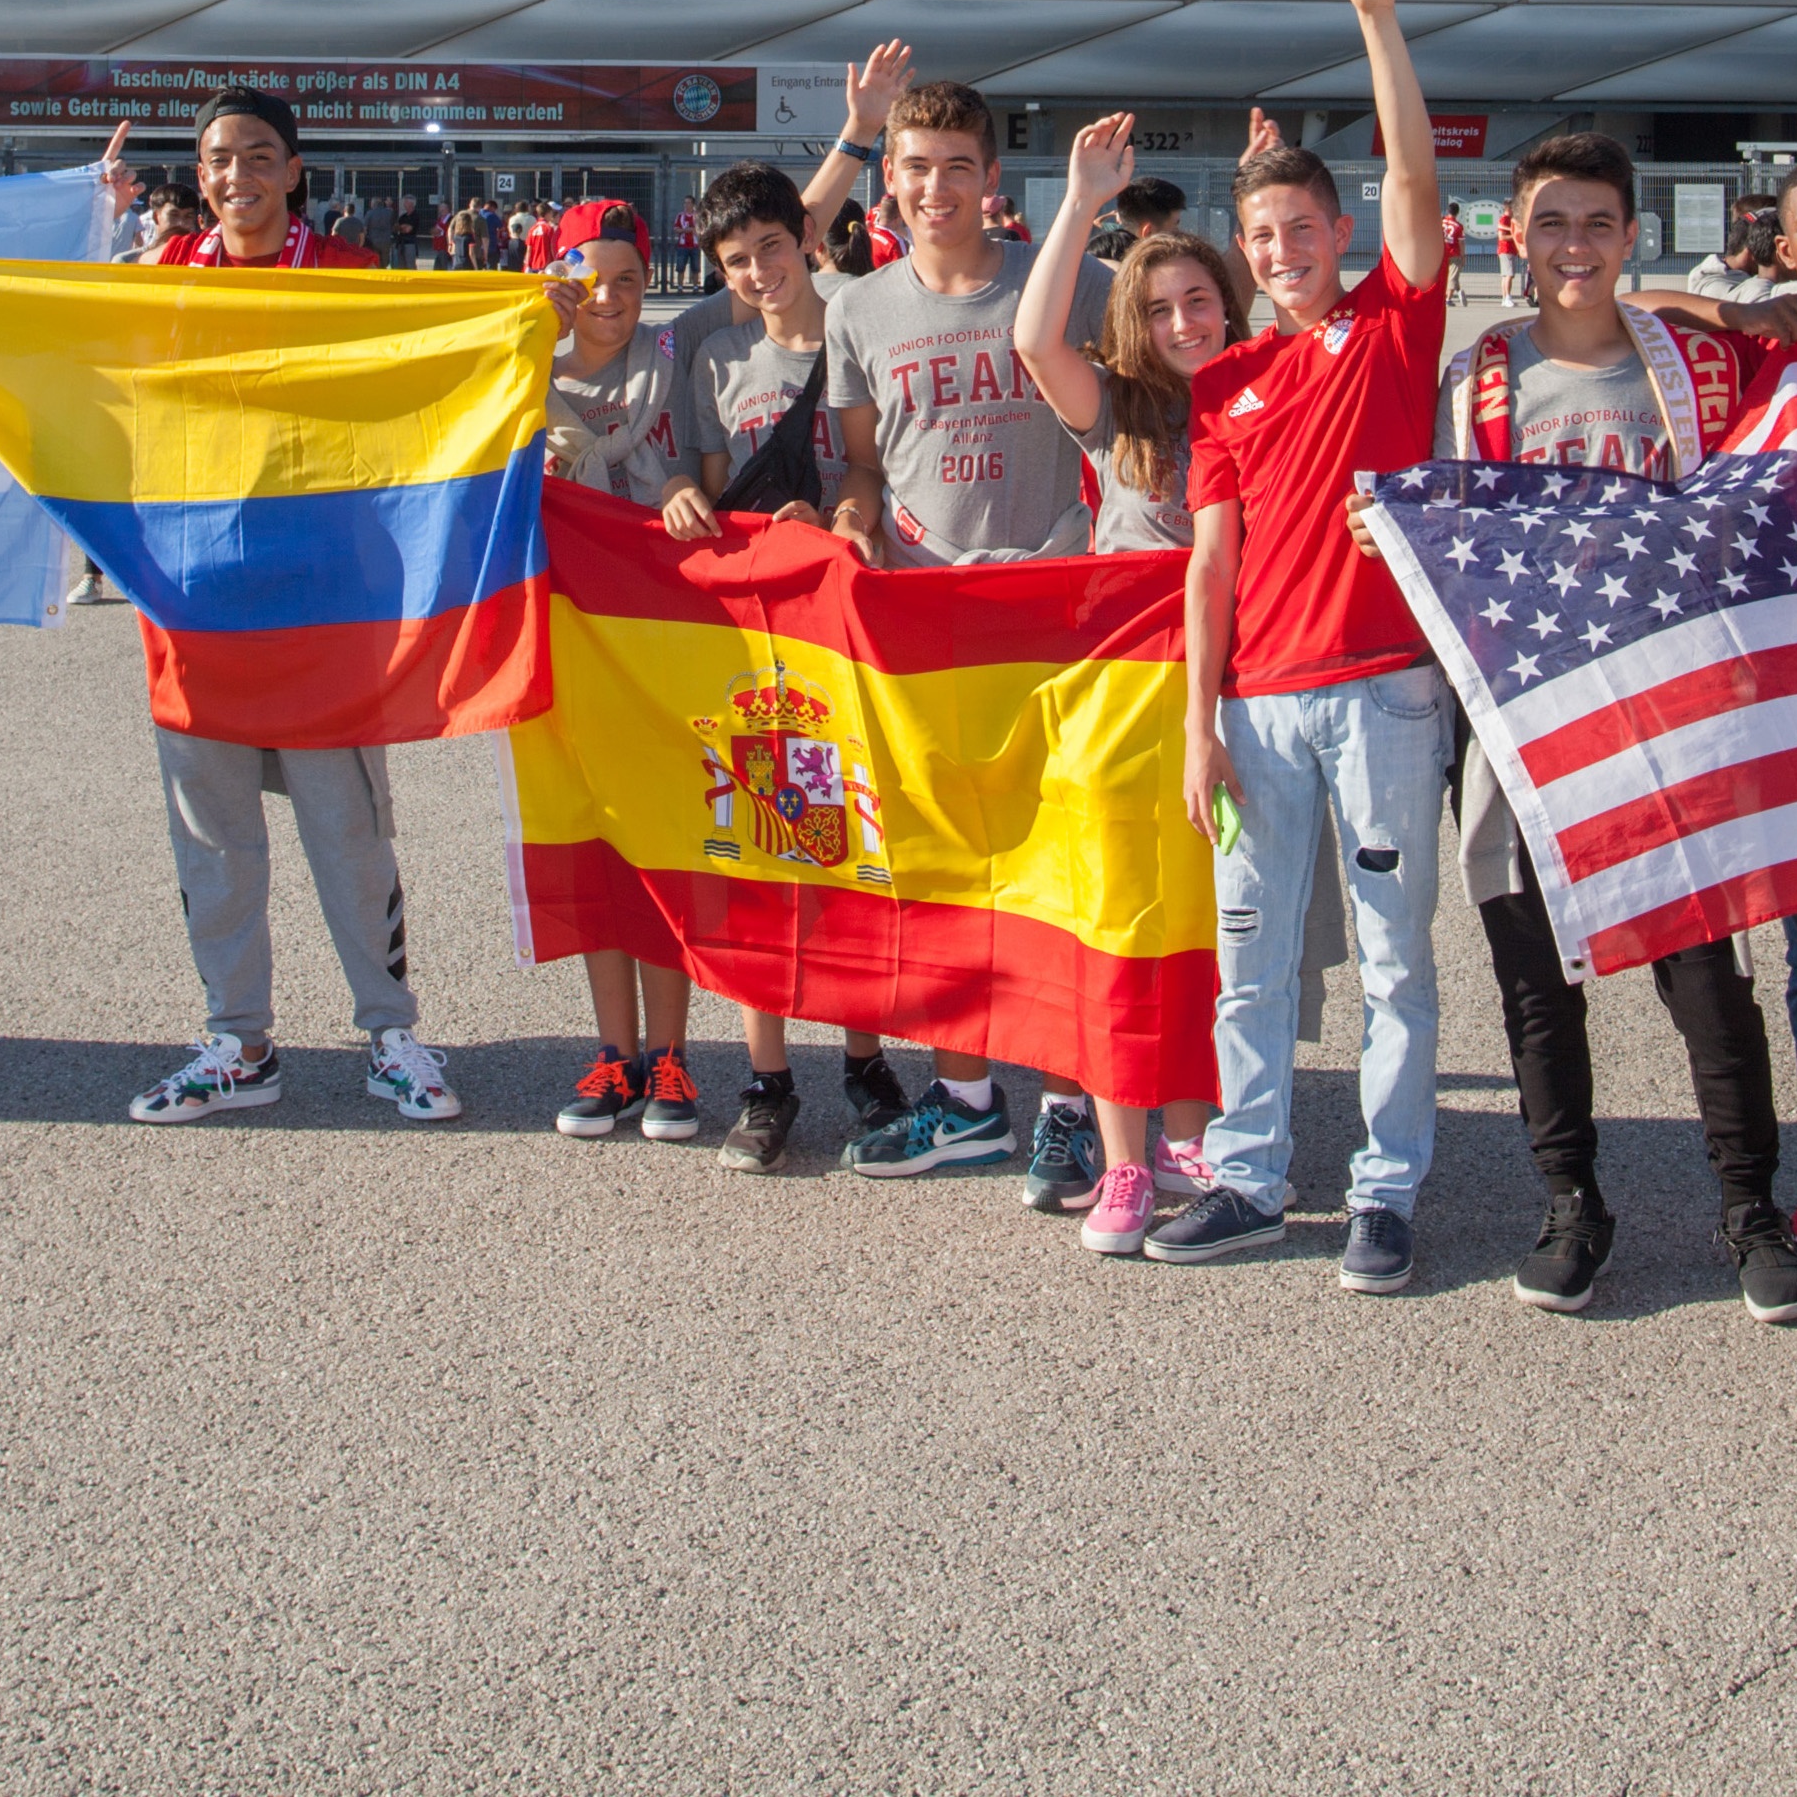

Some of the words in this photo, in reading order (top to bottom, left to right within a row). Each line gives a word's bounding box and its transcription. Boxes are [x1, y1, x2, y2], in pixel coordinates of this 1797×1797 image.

[112, 68, 290, 89] Taschen/Rucksäcke
[296, 72, 356, 93] größer
[363, 74, 388, 90] als
[395, 73, 428, 90] DIN
[434, 73, 460, 91] A4
[771, 76, 811, 90] Eingang
[814, 76, 848, 88] Entran
[10, 99, 61, 117] sowie
[68, 98, 151, 118] Getränke
[157, 100, 199, 118] aller
[307, 102, 353, 120] nicht
[359, 102, 487, 123] mitgenommen
[492, 103, 564, 121] werden!
[1007, 113, 1028, 149] E
[498, 177, 513, 189] 24
[1363, 184, 1378, 197] 20
[888, 336, 934, 359] JUNIOR
[937, 327, 1003, 346] FOOTBALL
[737, 390, 778, 414] JUNIOR
[1228, 400, 1265, 418] adidas
[915, 418, 928, 431] FC
[930, 417, 972, 432] Bayern
[974, 410, 1032, 426] München
[1511, 418, 1562, 444] JUNIOR
[1563, 409, 1635, 426] FOOTBALL
[952, 432, 994, 445] Allianz
[942, 452, 1003, 483] 2016
[1155, 511, 1172, 524] FC
